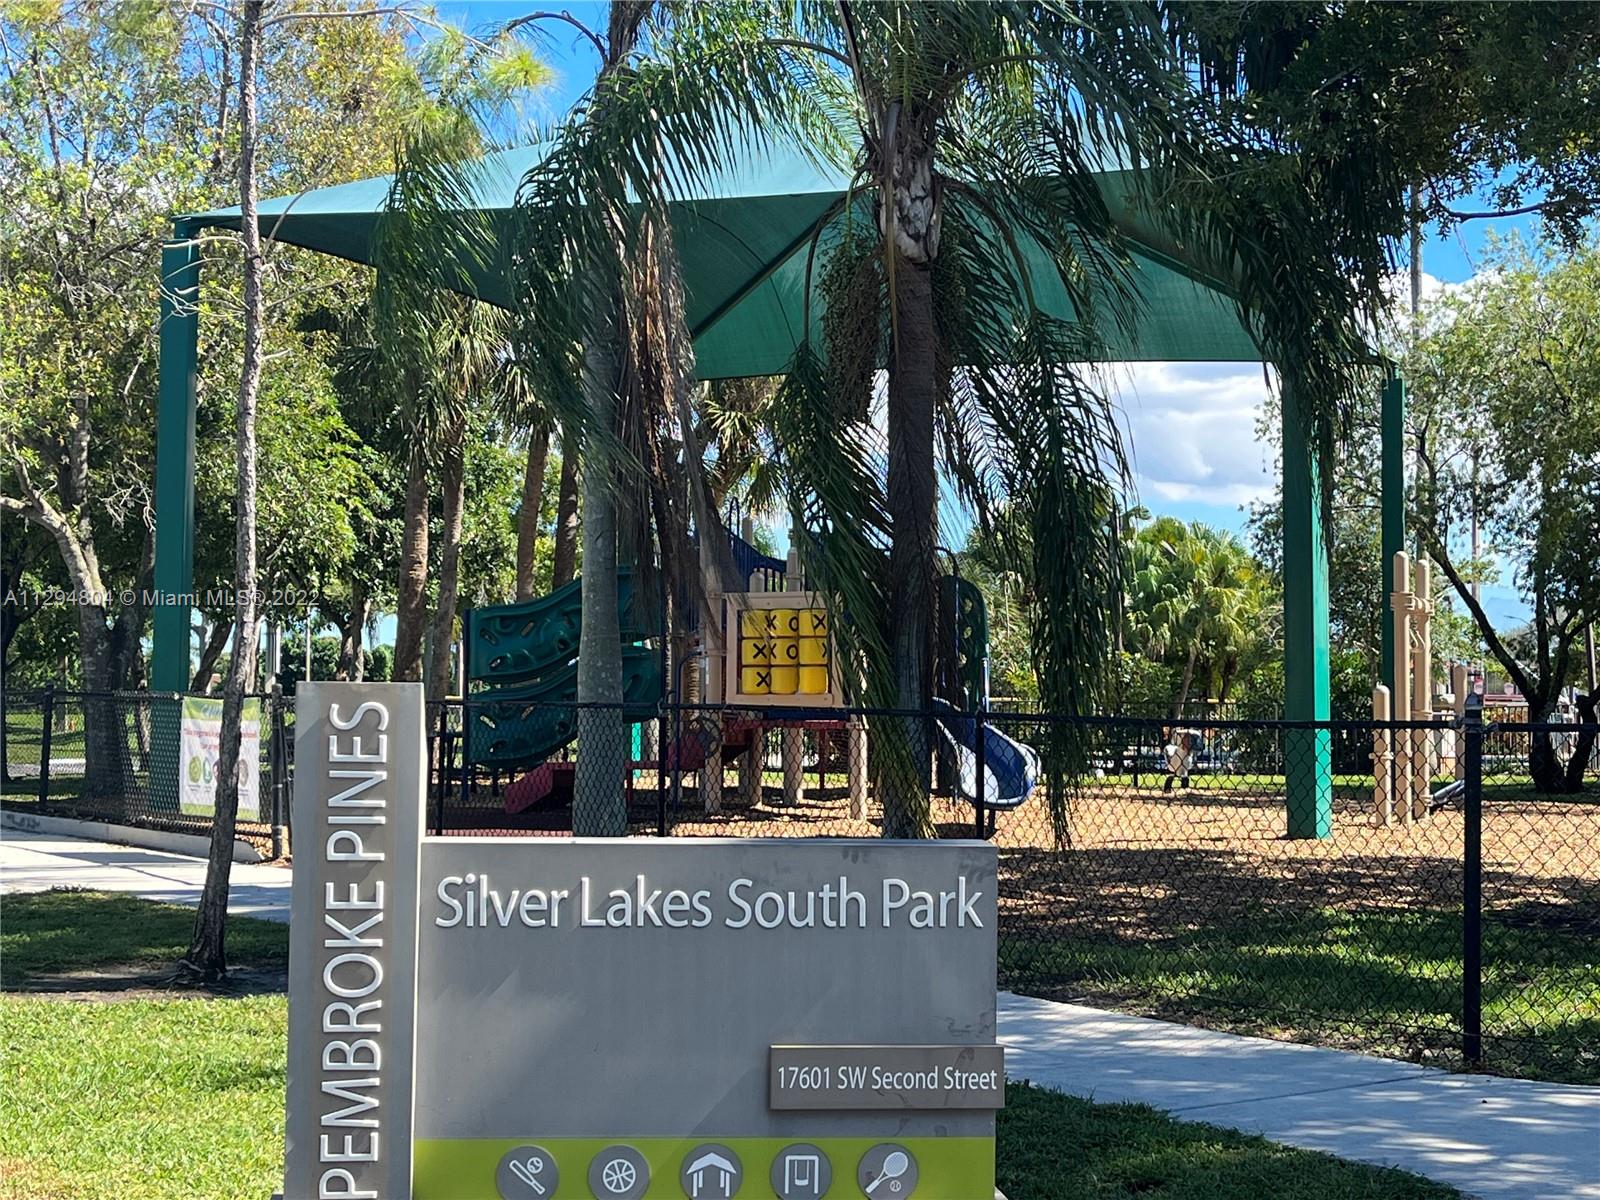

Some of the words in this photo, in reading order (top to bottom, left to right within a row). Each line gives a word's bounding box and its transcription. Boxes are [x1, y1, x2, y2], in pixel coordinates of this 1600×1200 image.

[326, 701, 390, 862] PINES
[435, 873, 569, 928] Silver
[580, 874, 713, 928] Lakes
[724, 876, 867, 928] South
[882, 876, 984, 929] Park
[318, 880, 385, 1200] PEMBROKE
[777, 1066, 831, 1090] 17601
[837, 1066, 868, 1090] SW
[871, 1065, 939, 1090] Second
[943, 1066, 998, 1091] Street
